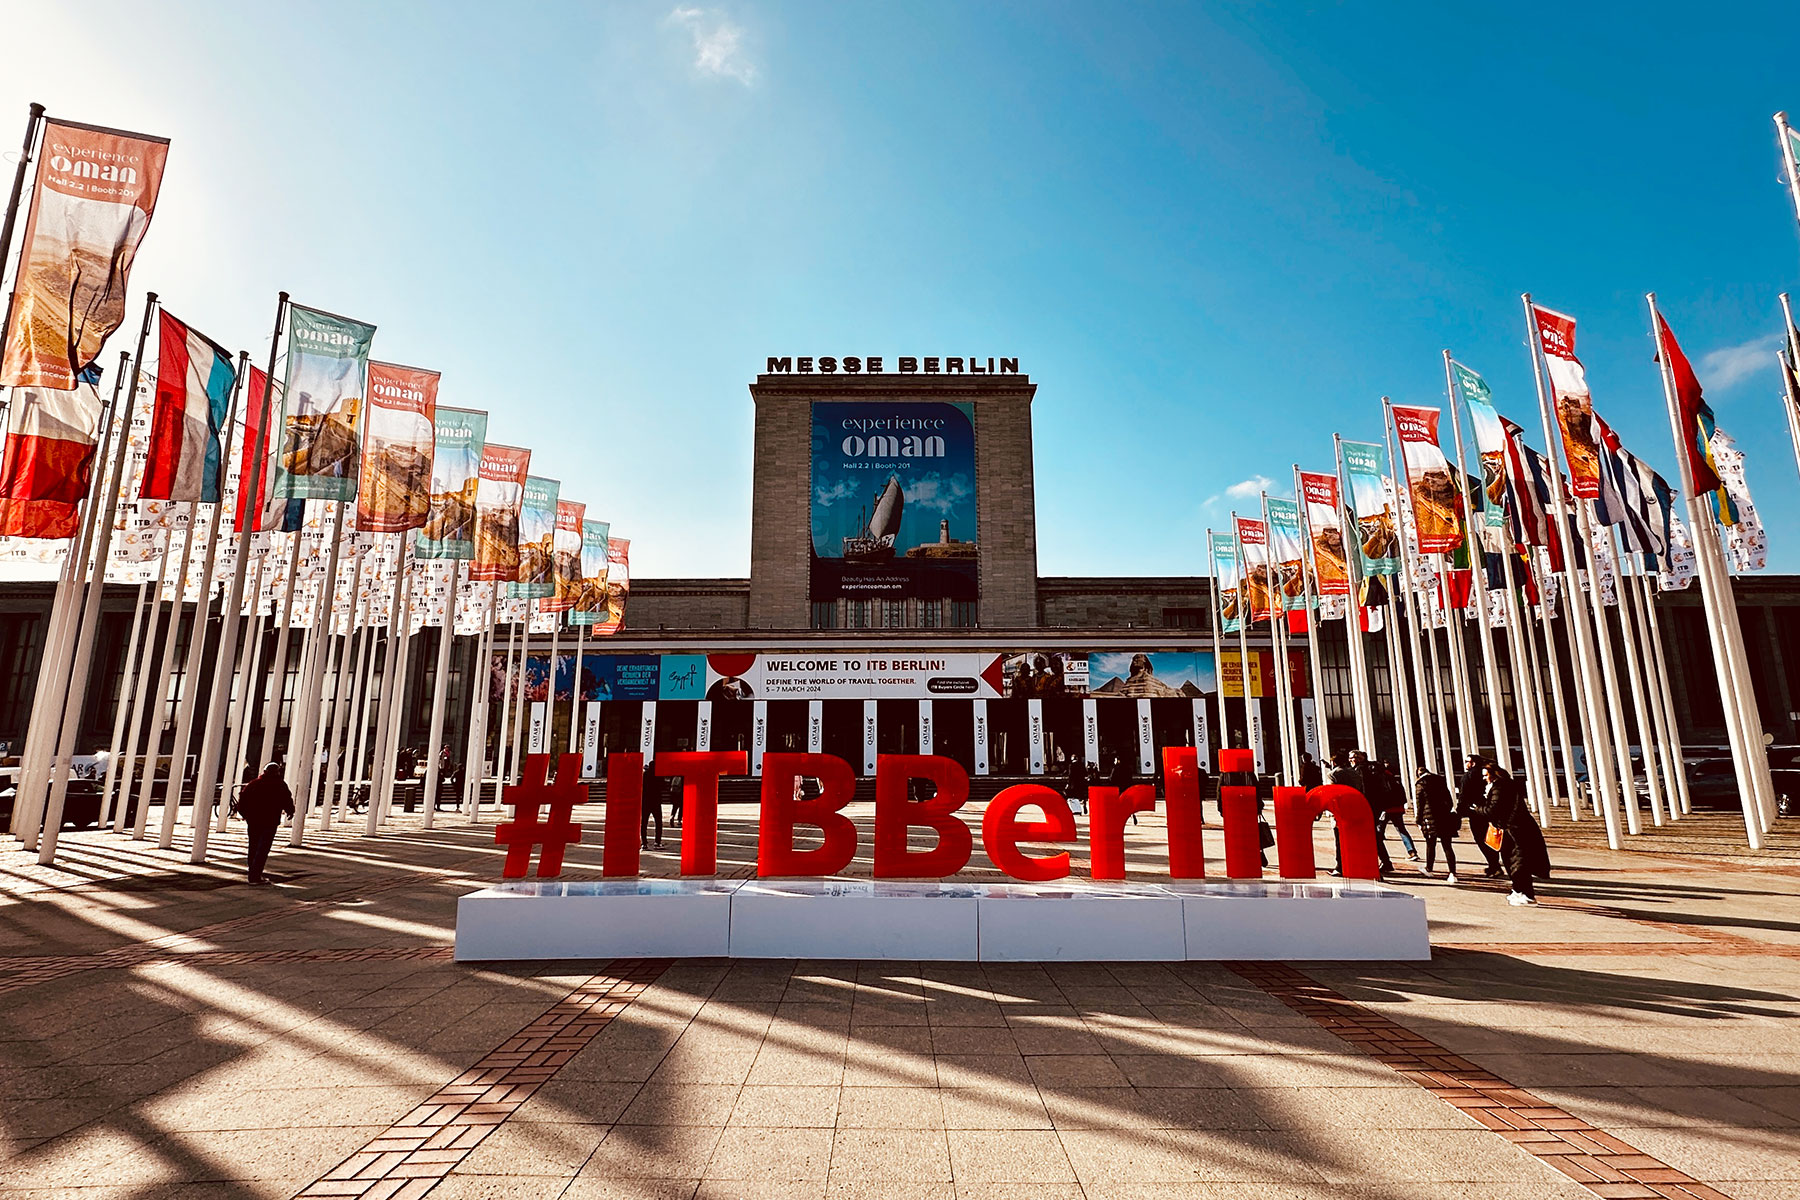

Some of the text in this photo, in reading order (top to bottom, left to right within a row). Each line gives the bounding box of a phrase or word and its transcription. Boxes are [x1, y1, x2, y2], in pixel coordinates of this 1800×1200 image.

[53, 143, 138, 164] experience
[50, 155, 137, 184] oman
[48, 175, 67, 185] Hall
[68, 181, 84, 190] 2.2
[91, 185, 117, 195] Booth
[118, 188, 134, 197] 201
[296, 328, 354, 345] oman
[767, 357, 1019, 373] MESSE BERLIN
[373, 384, 423, 402] oman
[842, 415, 945, 433] experience
[842, 435, 945, 457] oman
[480, 460, 517, 472] oman
[767, 660, 946, 671] WELCOME TO ITB BERLIN!
[495, 746, 1380, 881] #ITBBerlin
